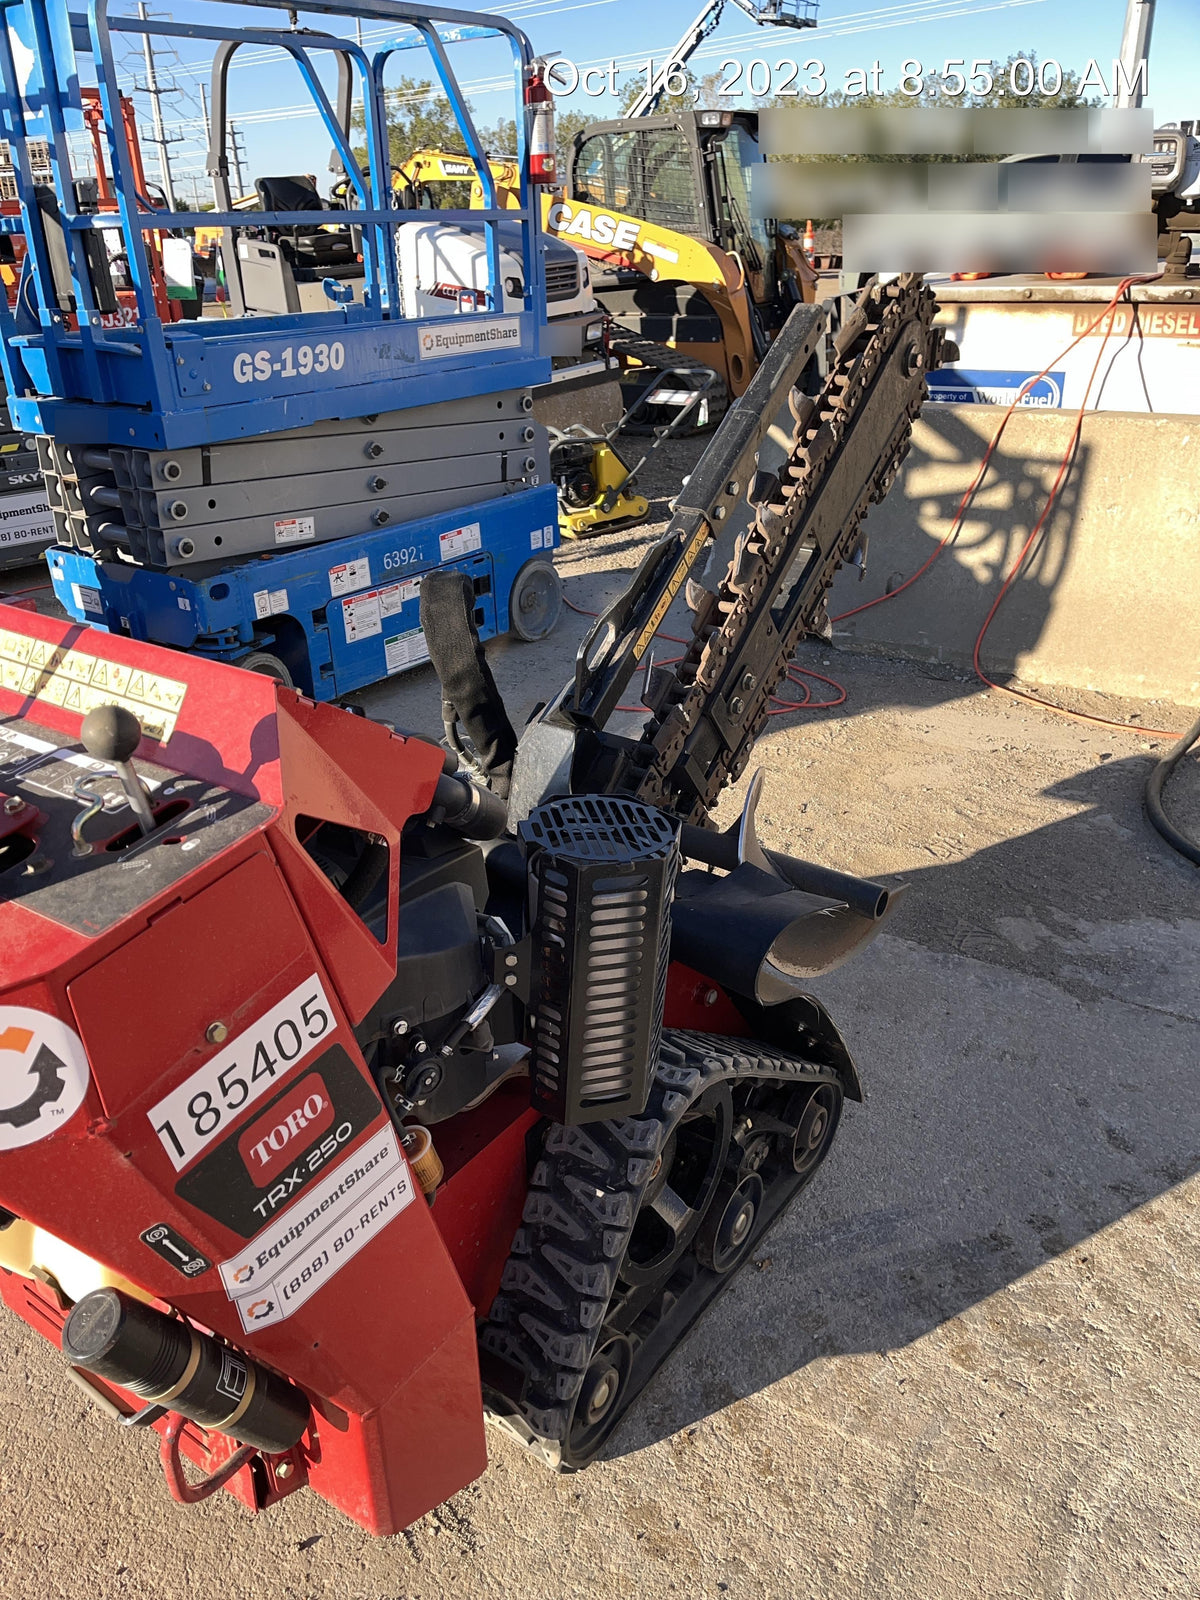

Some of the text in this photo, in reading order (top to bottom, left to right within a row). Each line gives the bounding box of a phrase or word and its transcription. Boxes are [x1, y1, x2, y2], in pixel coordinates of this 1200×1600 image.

[548, 203, 641, 252] CASE
[233, 341, 345, 384] GS-1930
[434, 327, 518, 347] EquipmentShare
[928, 391, 956, 403] roperty
[157, 993, 329, 1159] 185405
[250, 1093, 324, 1167] TORO
[255, 1146, 390, 1271] EquipmentShare
[333, 1179, 408, 1253] 80-RENTS
